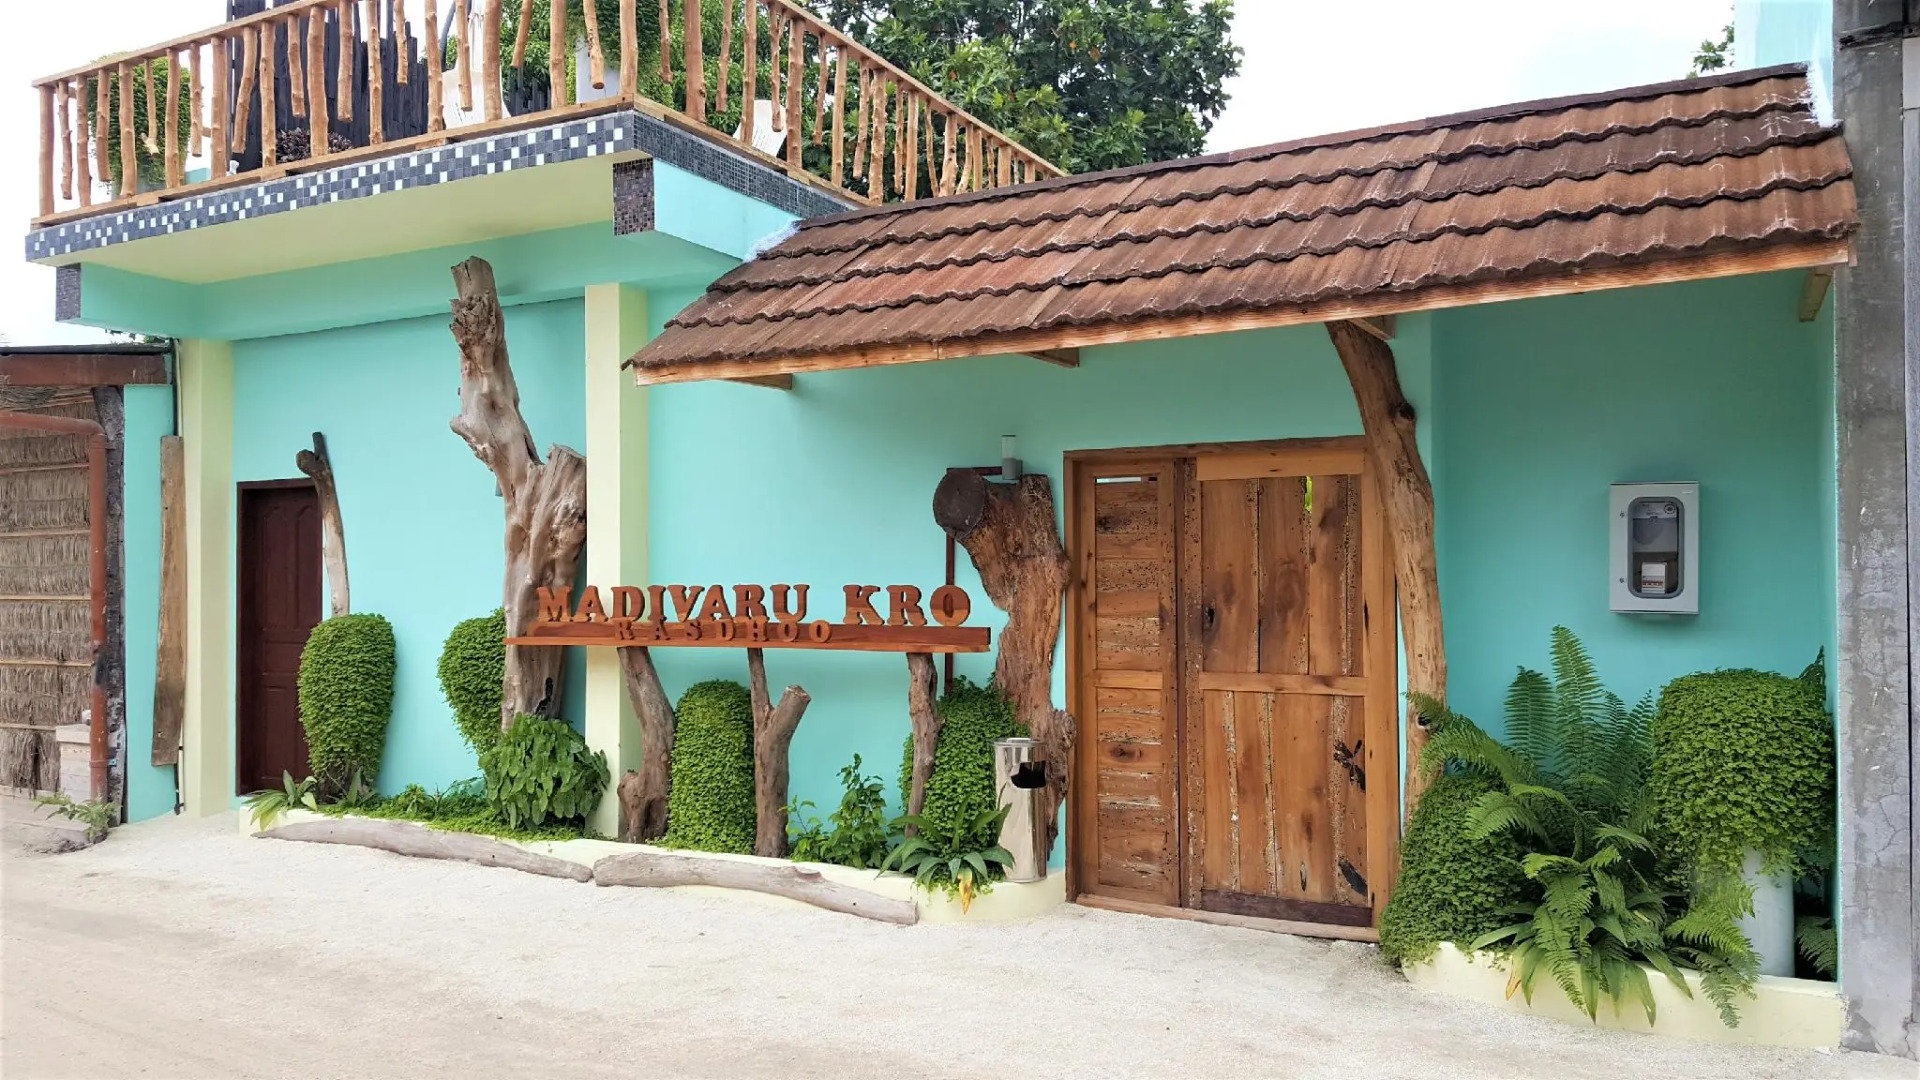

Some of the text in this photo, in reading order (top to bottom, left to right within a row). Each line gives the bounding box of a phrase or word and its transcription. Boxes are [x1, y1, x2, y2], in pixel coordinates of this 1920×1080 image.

[536, 584, 972, 626] MADIVARU KRO
[614, 617, 832, 643] RASDHOO
